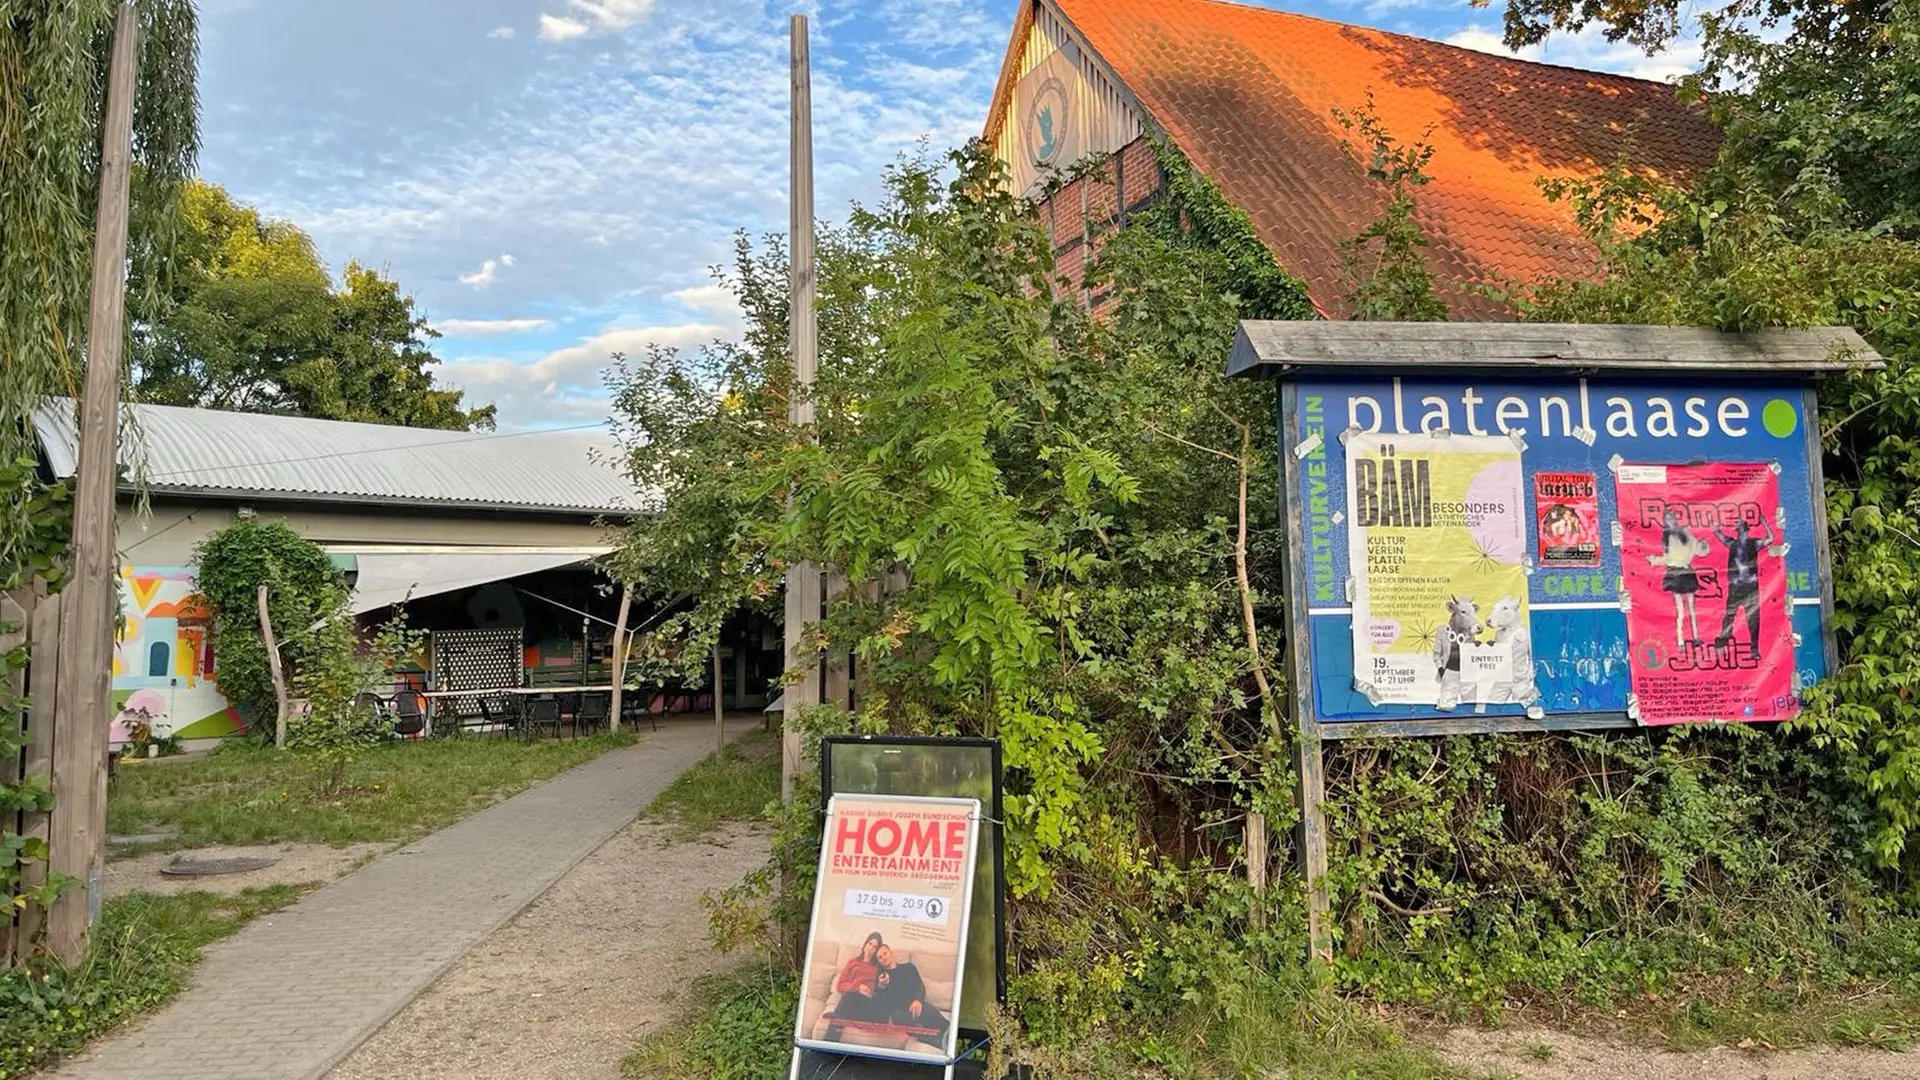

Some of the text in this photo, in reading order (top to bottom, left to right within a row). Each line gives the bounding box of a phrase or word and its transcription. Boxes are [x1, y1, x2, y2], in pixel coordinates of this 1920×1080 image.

[1348, 377, 1750, 438] platenlaase
[1355, 444, 1432, 528] BÄM
[1432, 503, 1505, 514] BESONDERS
[1367, 536, 1406, 545] KULTUR
[1367, 546, 1404, 554] VEREIN
[1368, 555, 1406, 564] PLATEN
[1368, 565, 1401, 574] LAASE
[1373, 657, 1389, 668] 19.
[835, 817, 966, 859] HOME
[833, 854, 962, 873] ENTERTAINMENT
[857, 893, 924, 909] 17.9 bis 20.9
